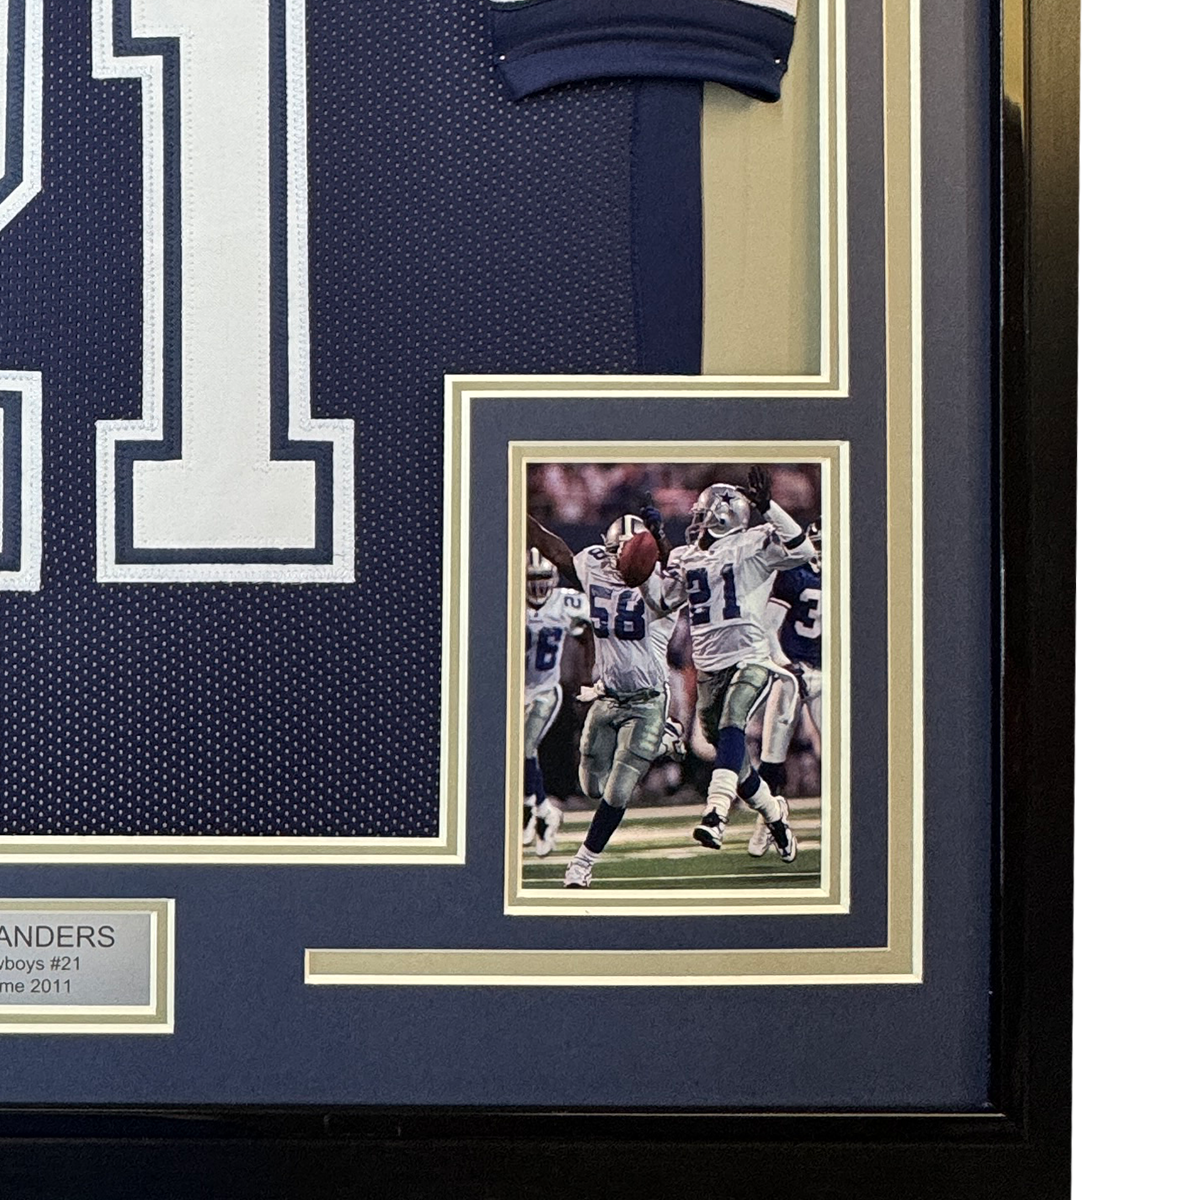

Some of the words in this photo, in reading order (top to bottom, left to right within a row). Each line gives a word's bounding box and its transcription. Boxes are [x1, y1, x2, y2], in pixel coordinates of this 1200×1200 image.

[589, 584, 646, 641] 58
[685, 563, 742, 626] 21
[50, 956, 80, 971] #21
[30, 979, 71, 993] 2011
